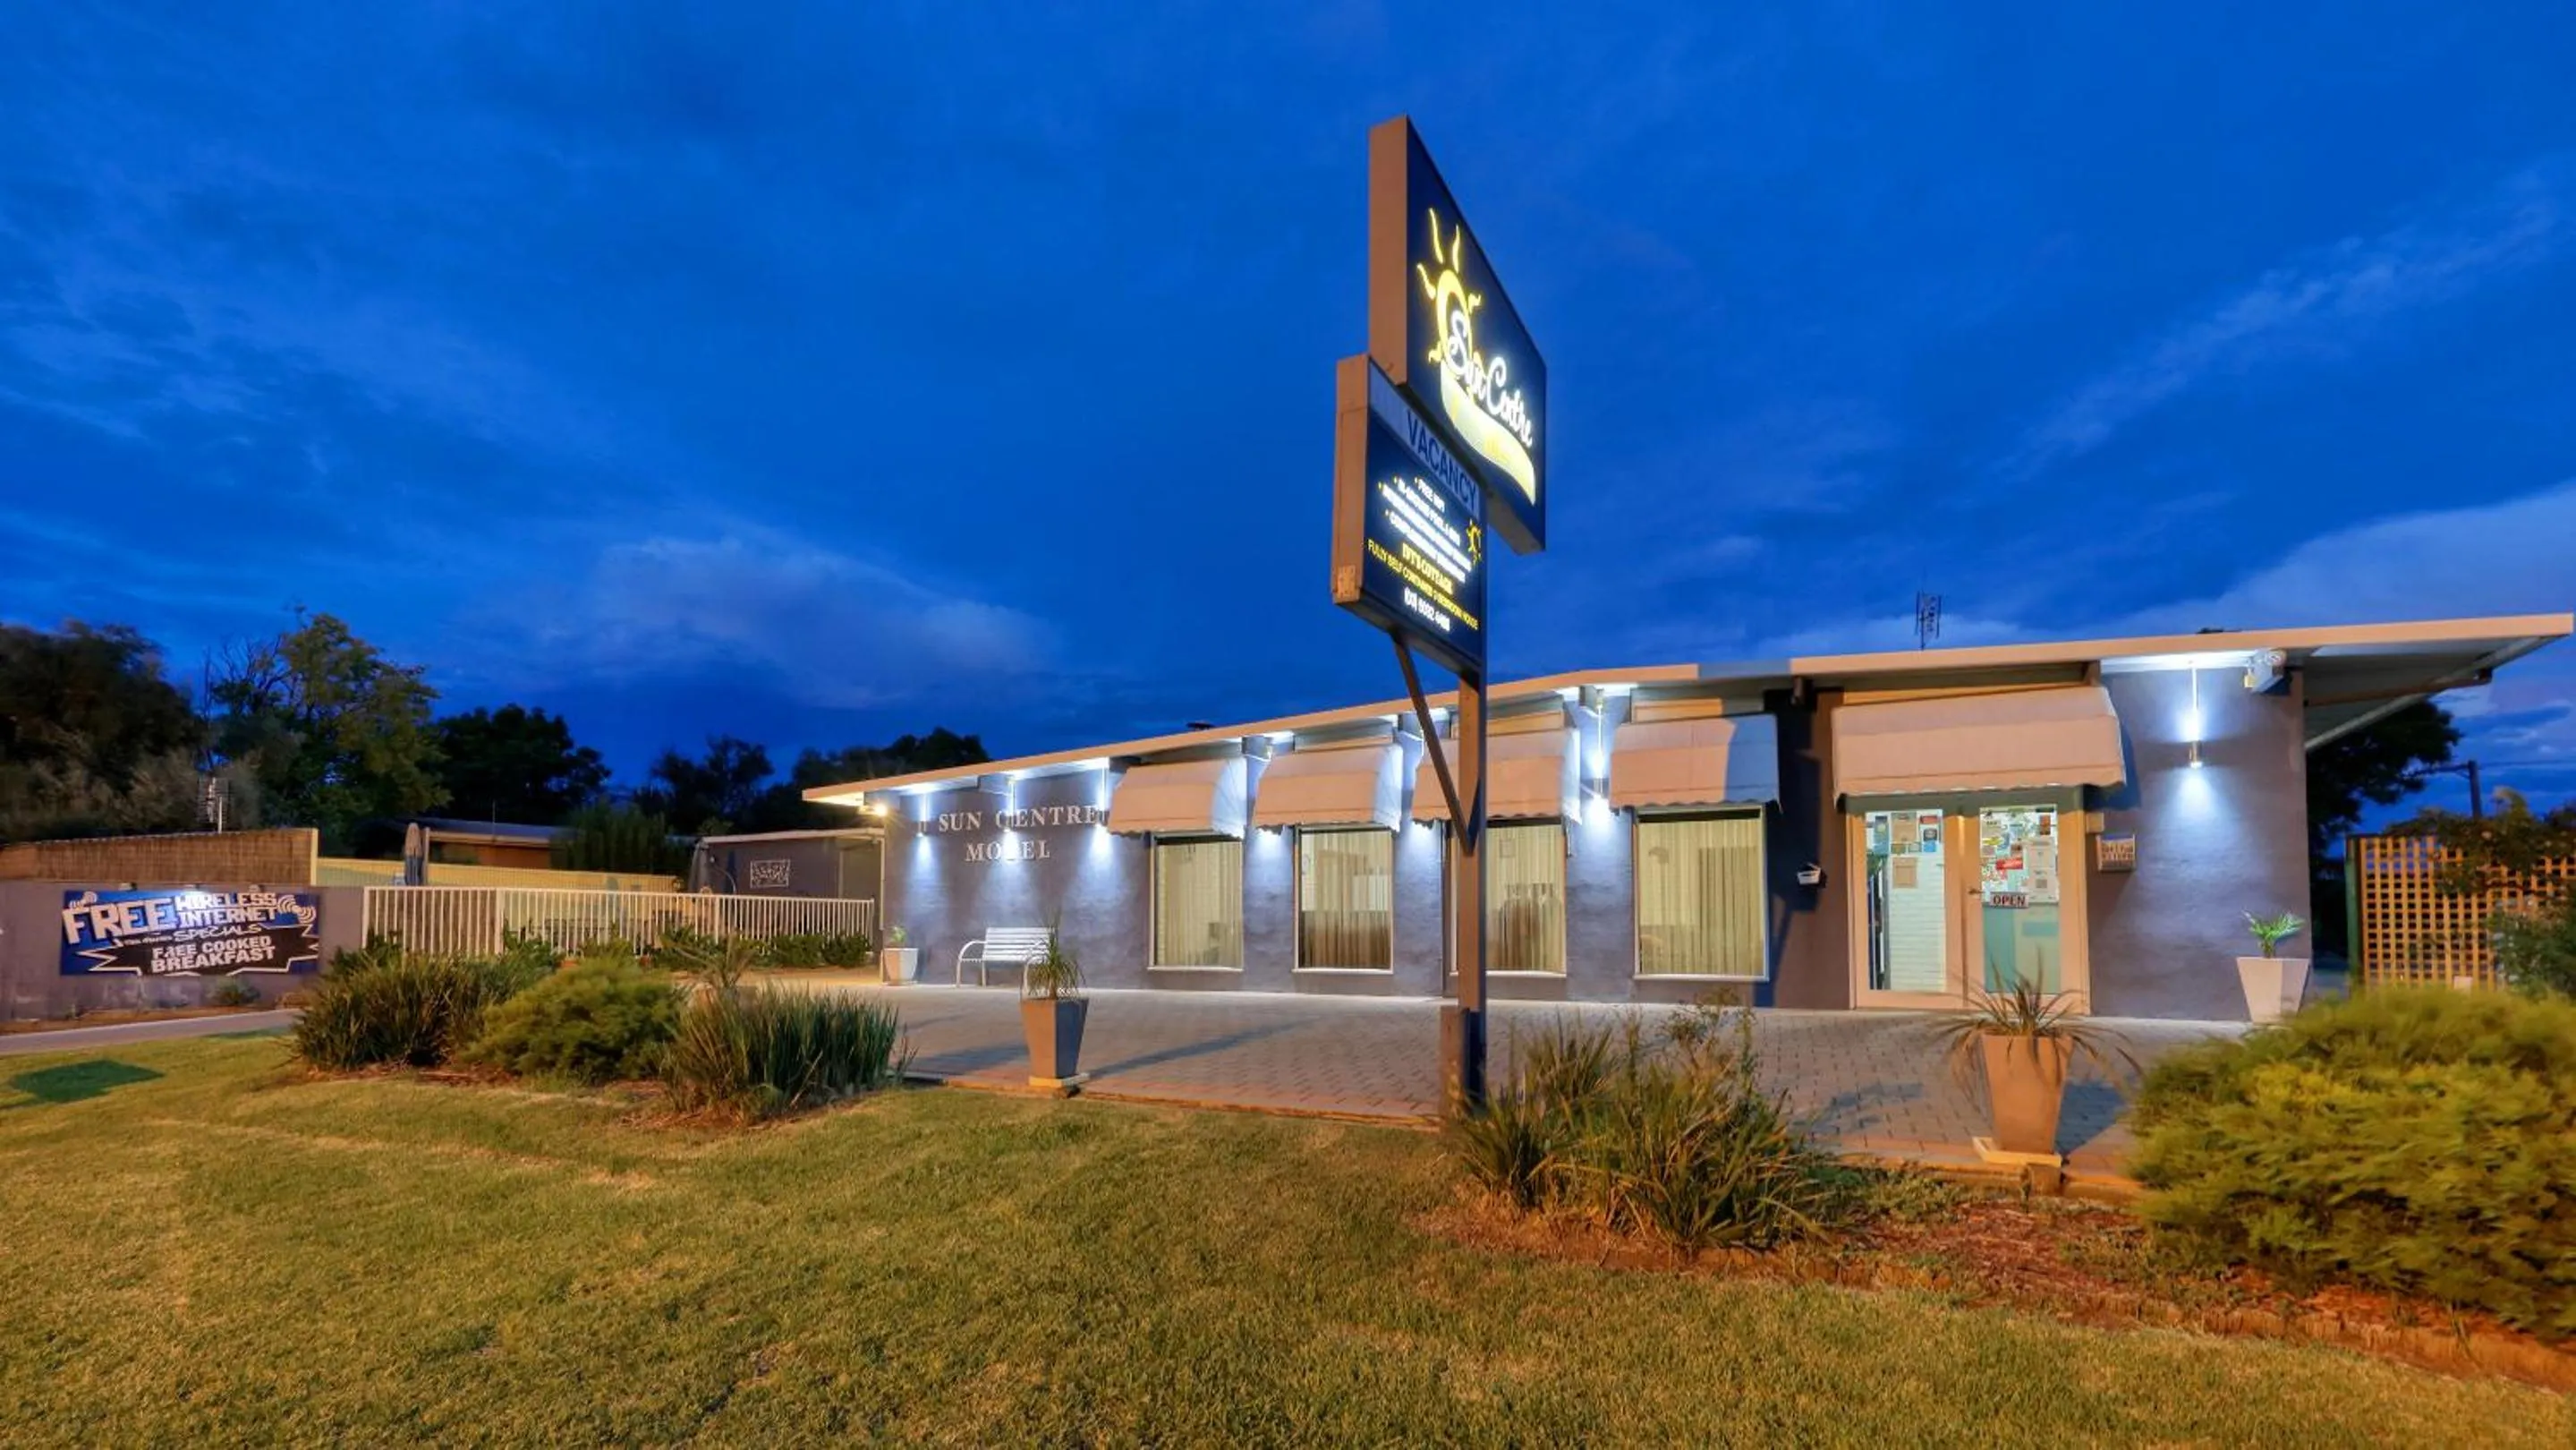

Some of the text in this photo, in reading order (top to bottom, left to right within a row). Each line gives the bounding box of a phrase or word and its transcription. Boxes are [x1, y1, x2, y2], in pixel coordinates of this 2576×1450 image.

[1406, 408, 1476, 509] VACANCY
[939, 812, 983, 832] SUN
[174, 892, 277, 912] WIRELESS
[1993, 895, 2026, 905] OPEN
[62, 897, 177, 944] FREE
[179, 907, 277, 929] INTERNET
[174, 925, 262, 942] SPECIALS
[201, 935, 271, 953] COOKED
[150, 946, 276, 973] BREAKFAST
